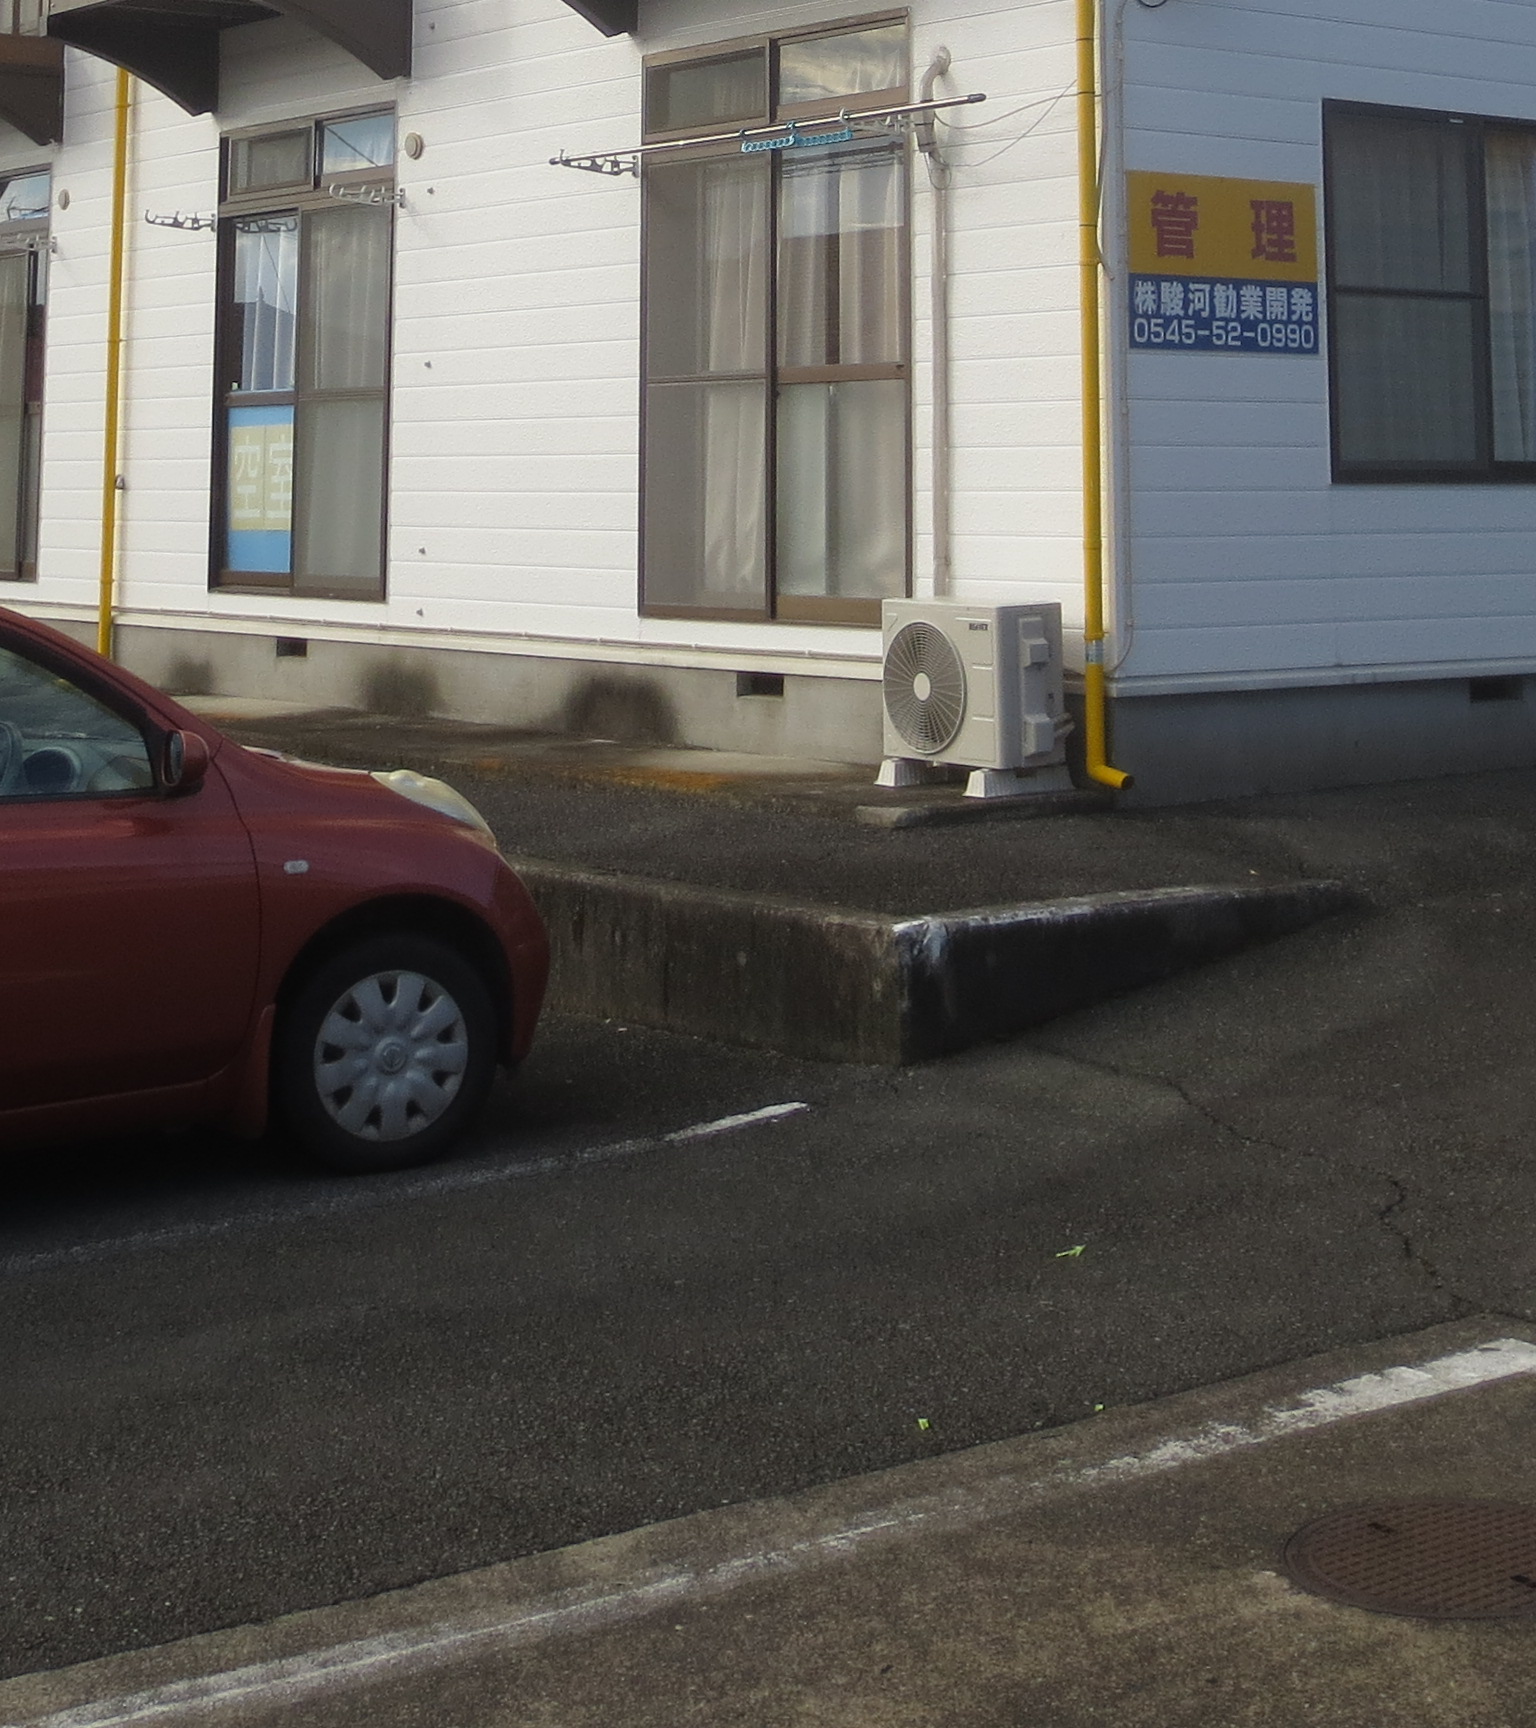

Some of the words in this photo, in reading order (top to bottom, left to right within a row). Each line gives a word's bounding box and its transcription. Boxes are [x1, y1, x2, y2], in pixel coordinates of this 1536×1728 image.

[1150, 189, 1297, 262] 管理
[1134, 318, 1314, 348] 0545-52-0990
[234, 433, 293, 519] 空室
